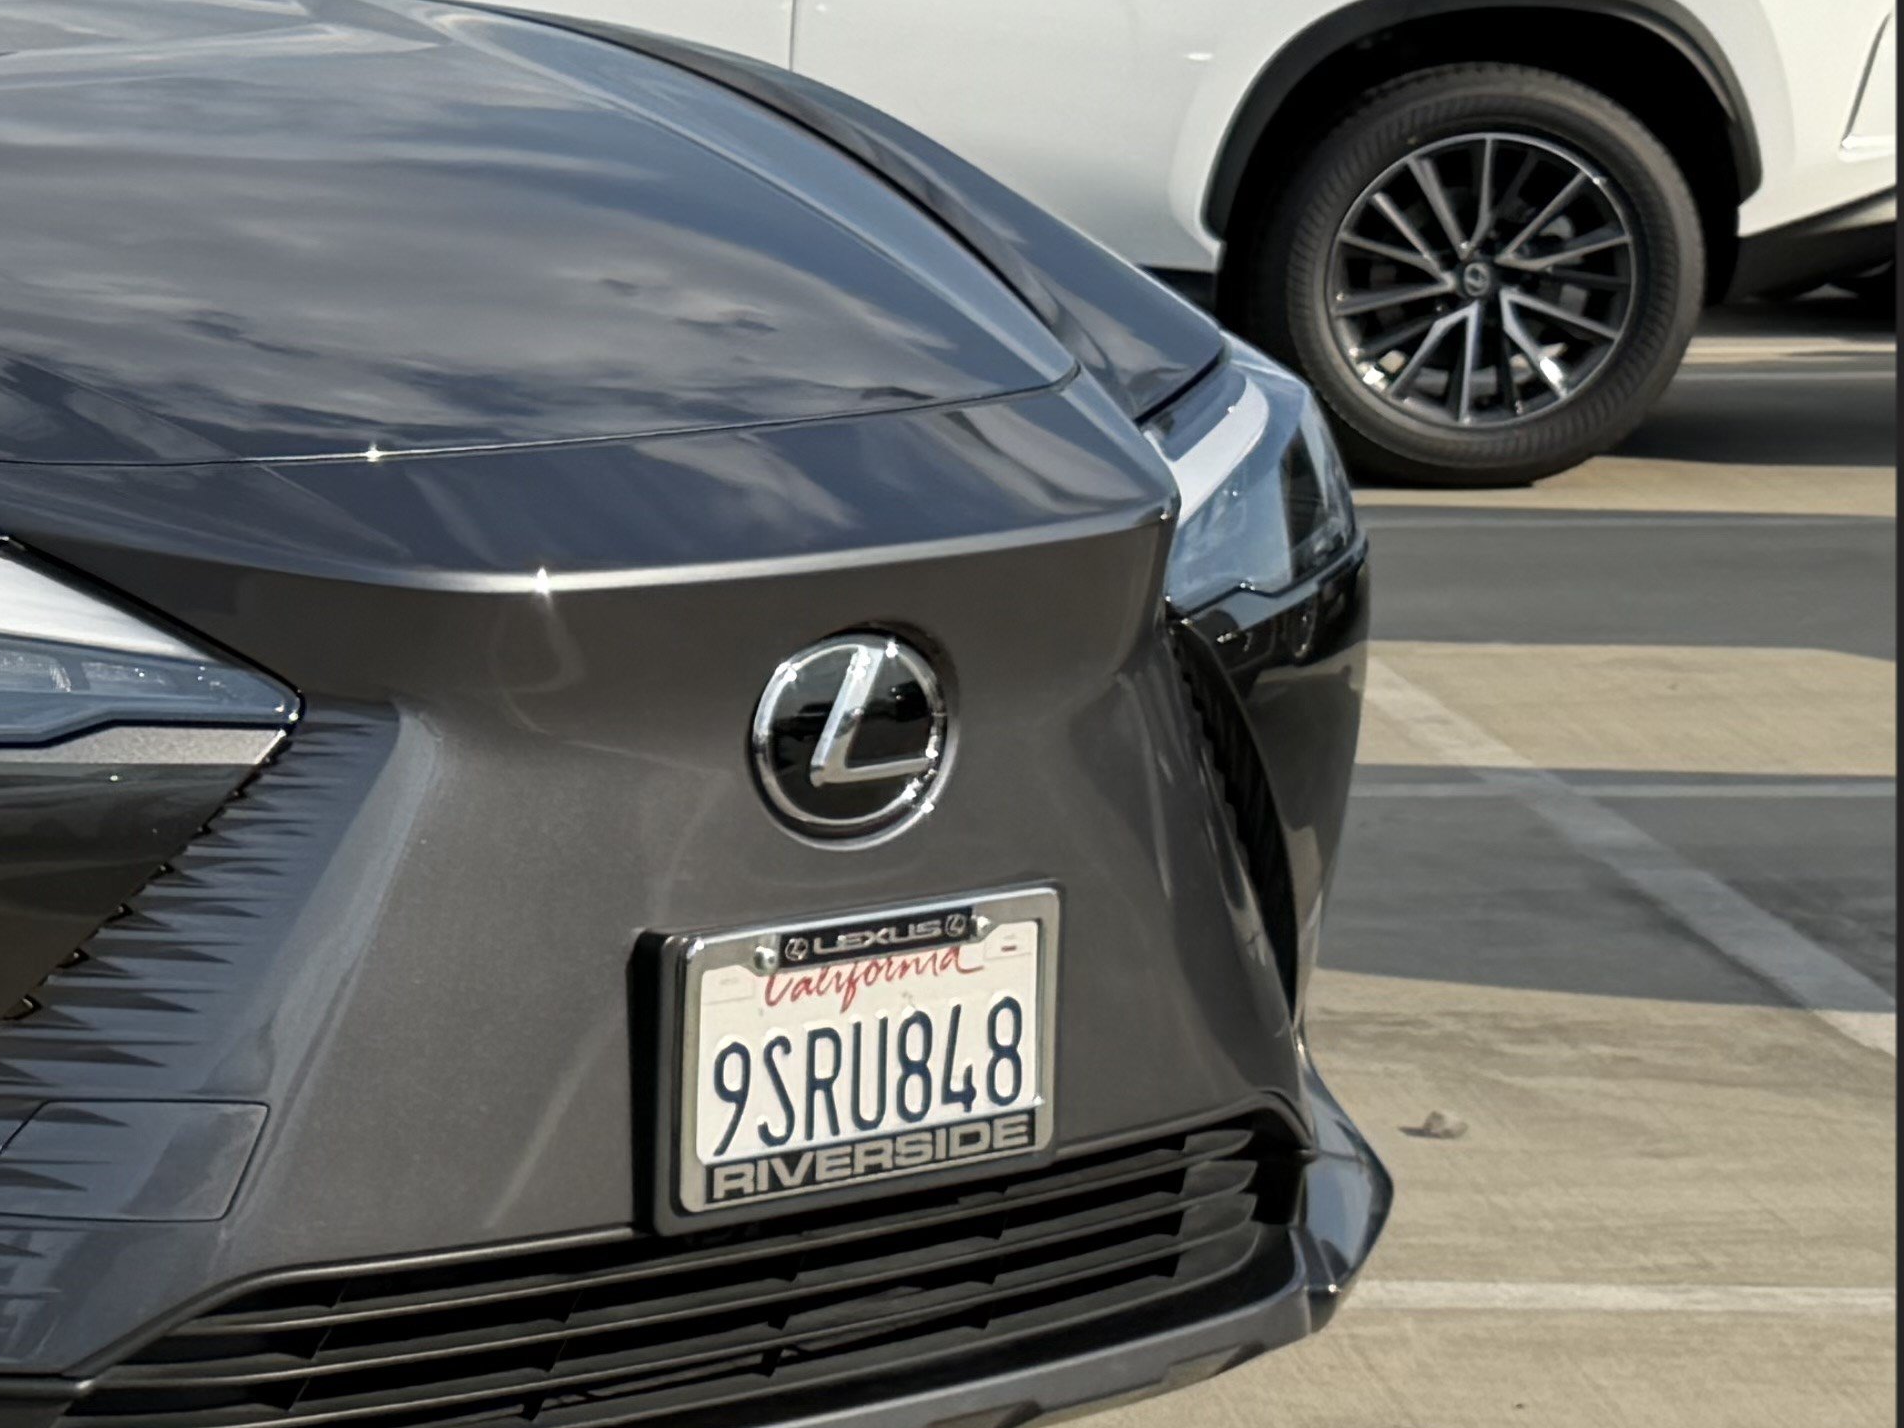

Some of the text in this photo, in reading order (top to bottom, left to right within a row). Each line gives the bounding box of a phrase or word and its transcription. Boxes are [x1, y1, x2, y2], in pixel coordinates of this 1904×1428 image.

[811, 918, 945, 957] LEXUS
[763, 945, 985, 1013] California
[712, 994, 1024, 1158] 9SRU848
[711, 1112, 1032, 1201] RIVERSIDE
